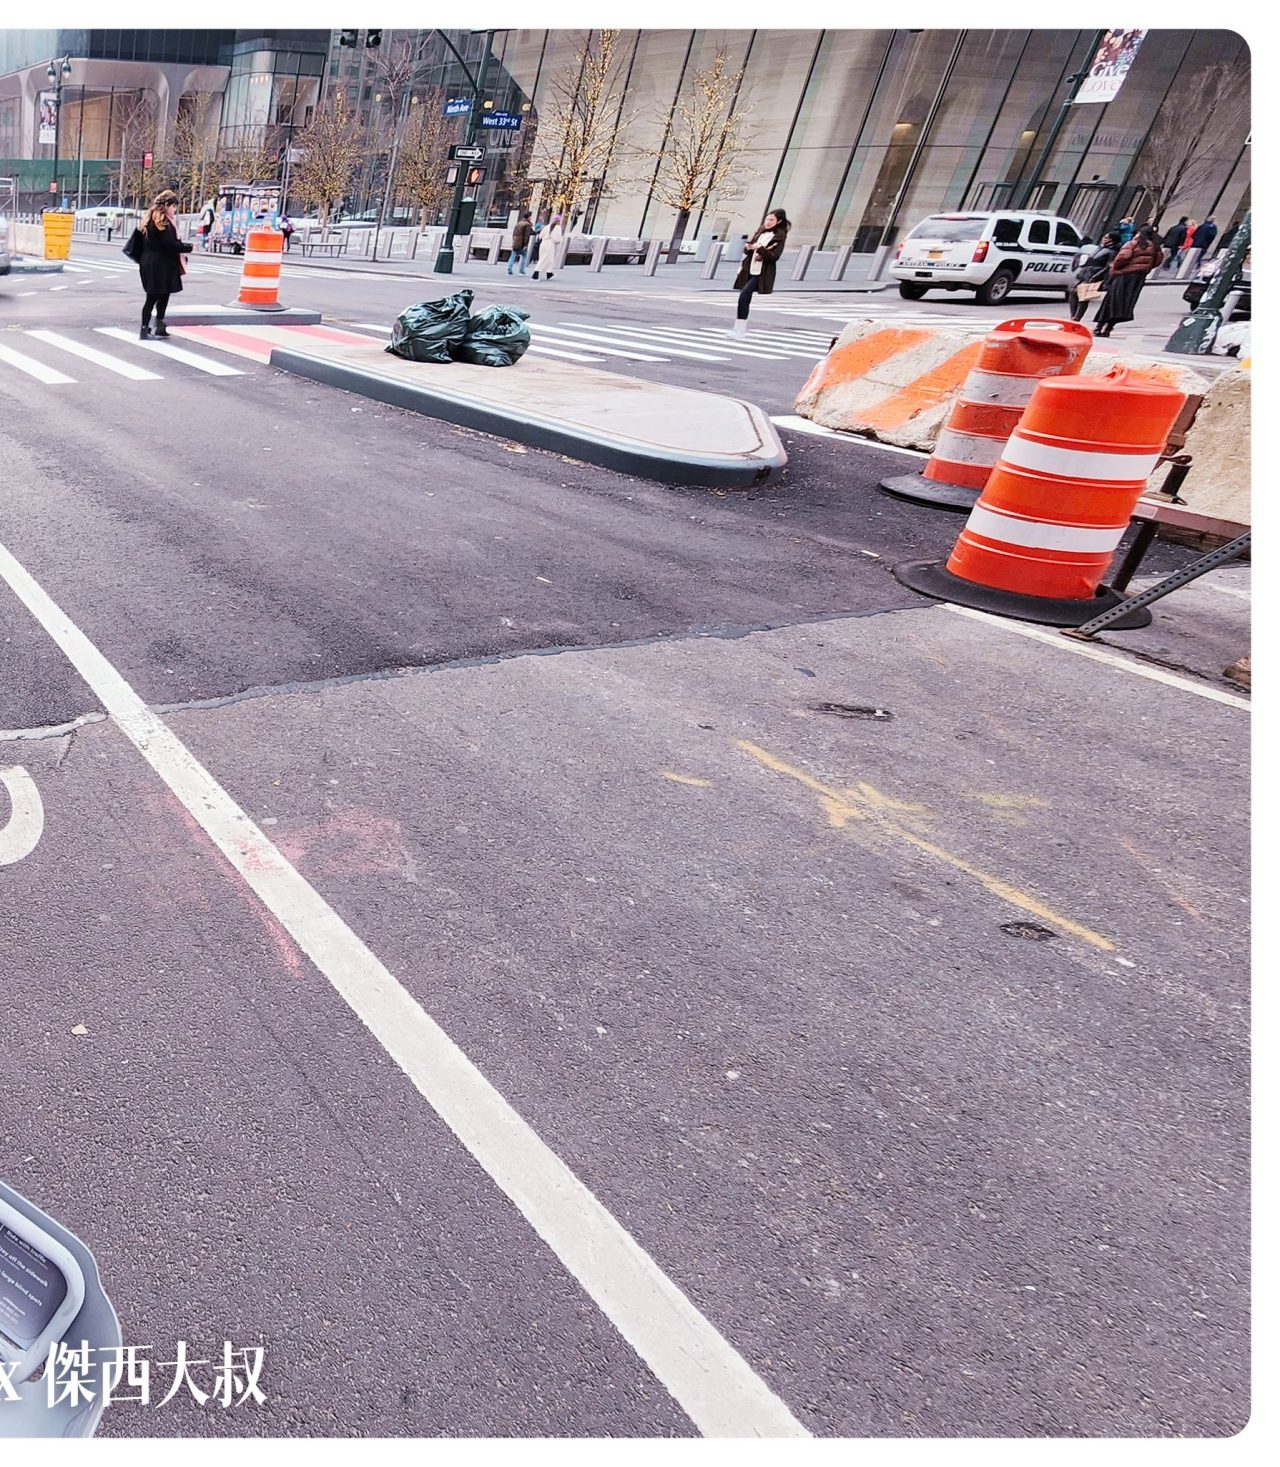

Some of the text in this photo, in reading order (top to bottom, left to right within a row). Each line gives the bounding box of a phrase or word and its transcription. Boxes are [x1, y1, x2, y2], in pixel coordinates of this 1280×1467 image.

[1089, 61, 1130, 77] Give
[482, 117, 518, 127] West 33rd St
[1024, 262, 1070, 273] POLICE
[18, 1240, 31, 1251] with
[29, 1248, 47, 1263] traffic
[8, 1254, 17, 1262] off
[16, 1260, 26, 1269] the
[25, 1267, 49, 1287] sidewalk
[0, 1270, 16, 1285] large
[14, 1282, 30, 1295] blind
[27, 1293, 43, 1307] spots
